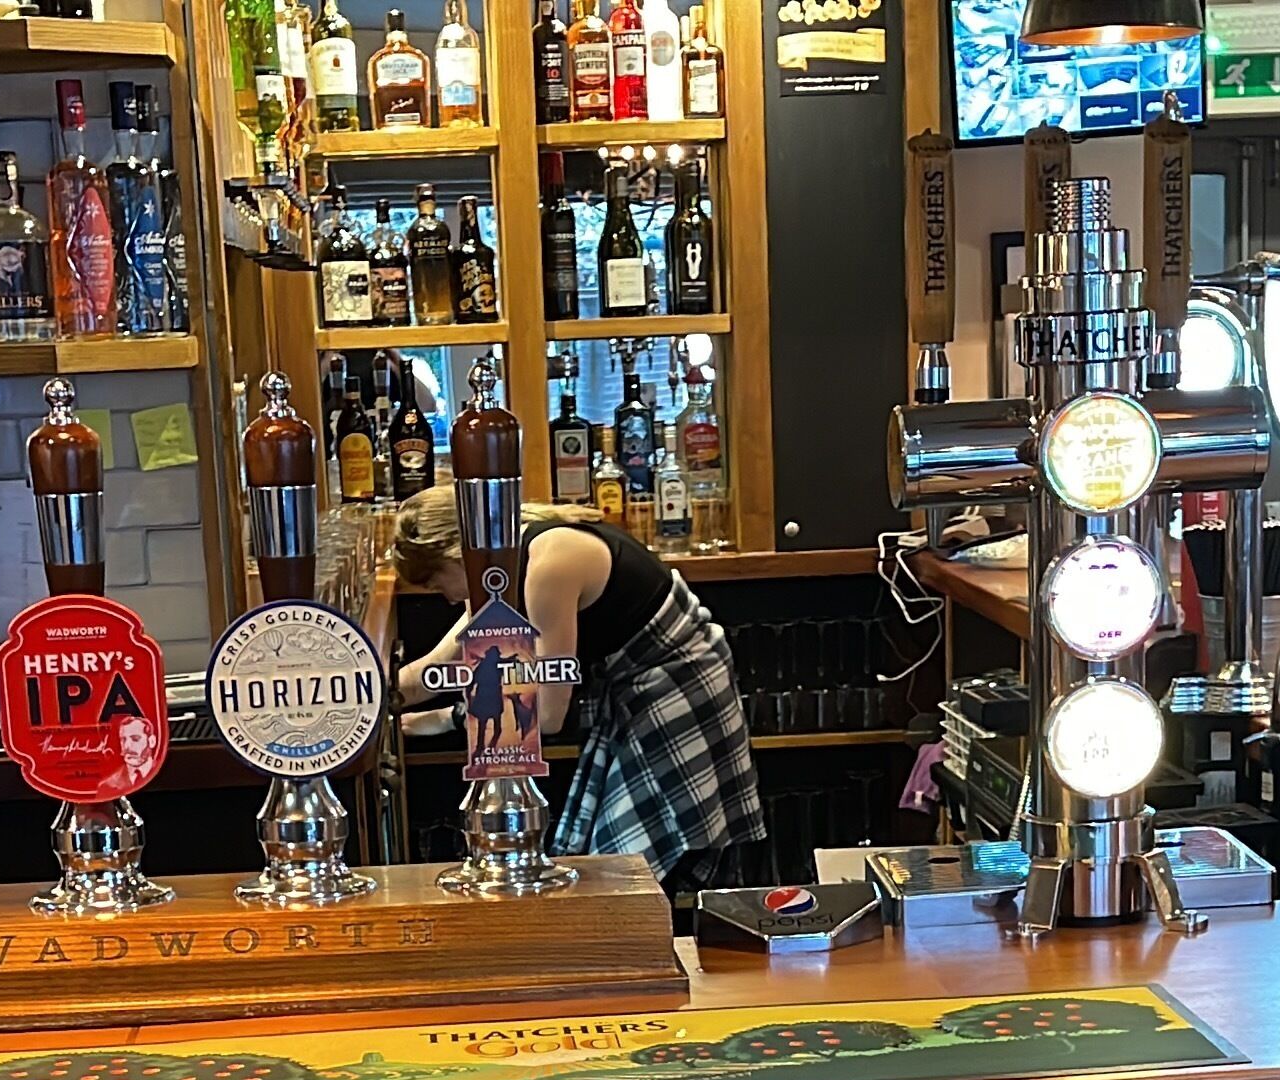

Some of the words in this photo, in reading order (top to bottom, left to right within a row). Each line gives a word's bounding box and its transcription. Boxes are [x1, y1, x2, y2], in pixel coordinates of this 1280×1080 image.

[1154, 155, 1183, 281] THATCHERS
[923, 169, 946, 296] THATCHERS
[46, 626, 108, 637] WADWORTH
[222, 622, 258, 666] CRISP
[265, 611, 337, 631] GOLDEN
[341, 632, 367, 659] ALE
[467, 627, 532, 638] WADWORTH
[23, 651, 135, 675] HENRY's
[424, 666, 474, 690] OLD
[497, 659, 578, 686] TIMER
[26, 671, 146, 727] IPA
[220, 671, 374, 713] HORIZON
[228, 726, 283, 769] CRAFTED
[289, 761, 304, 771] IN
[310, 715, 371, 768] WILTSHIRE
[273, 744, 327, 756] CHILLED
[484, 746, 525, 755] CLASSIC
[475, 756, 515, 765] STRONG
[518, 754, 537, 762] ALE
[757, 914, 834, 931] pepsi
[419, 1020, 670, 1044] THATCHERS
[464, 1033, 622, 1058] Gold
